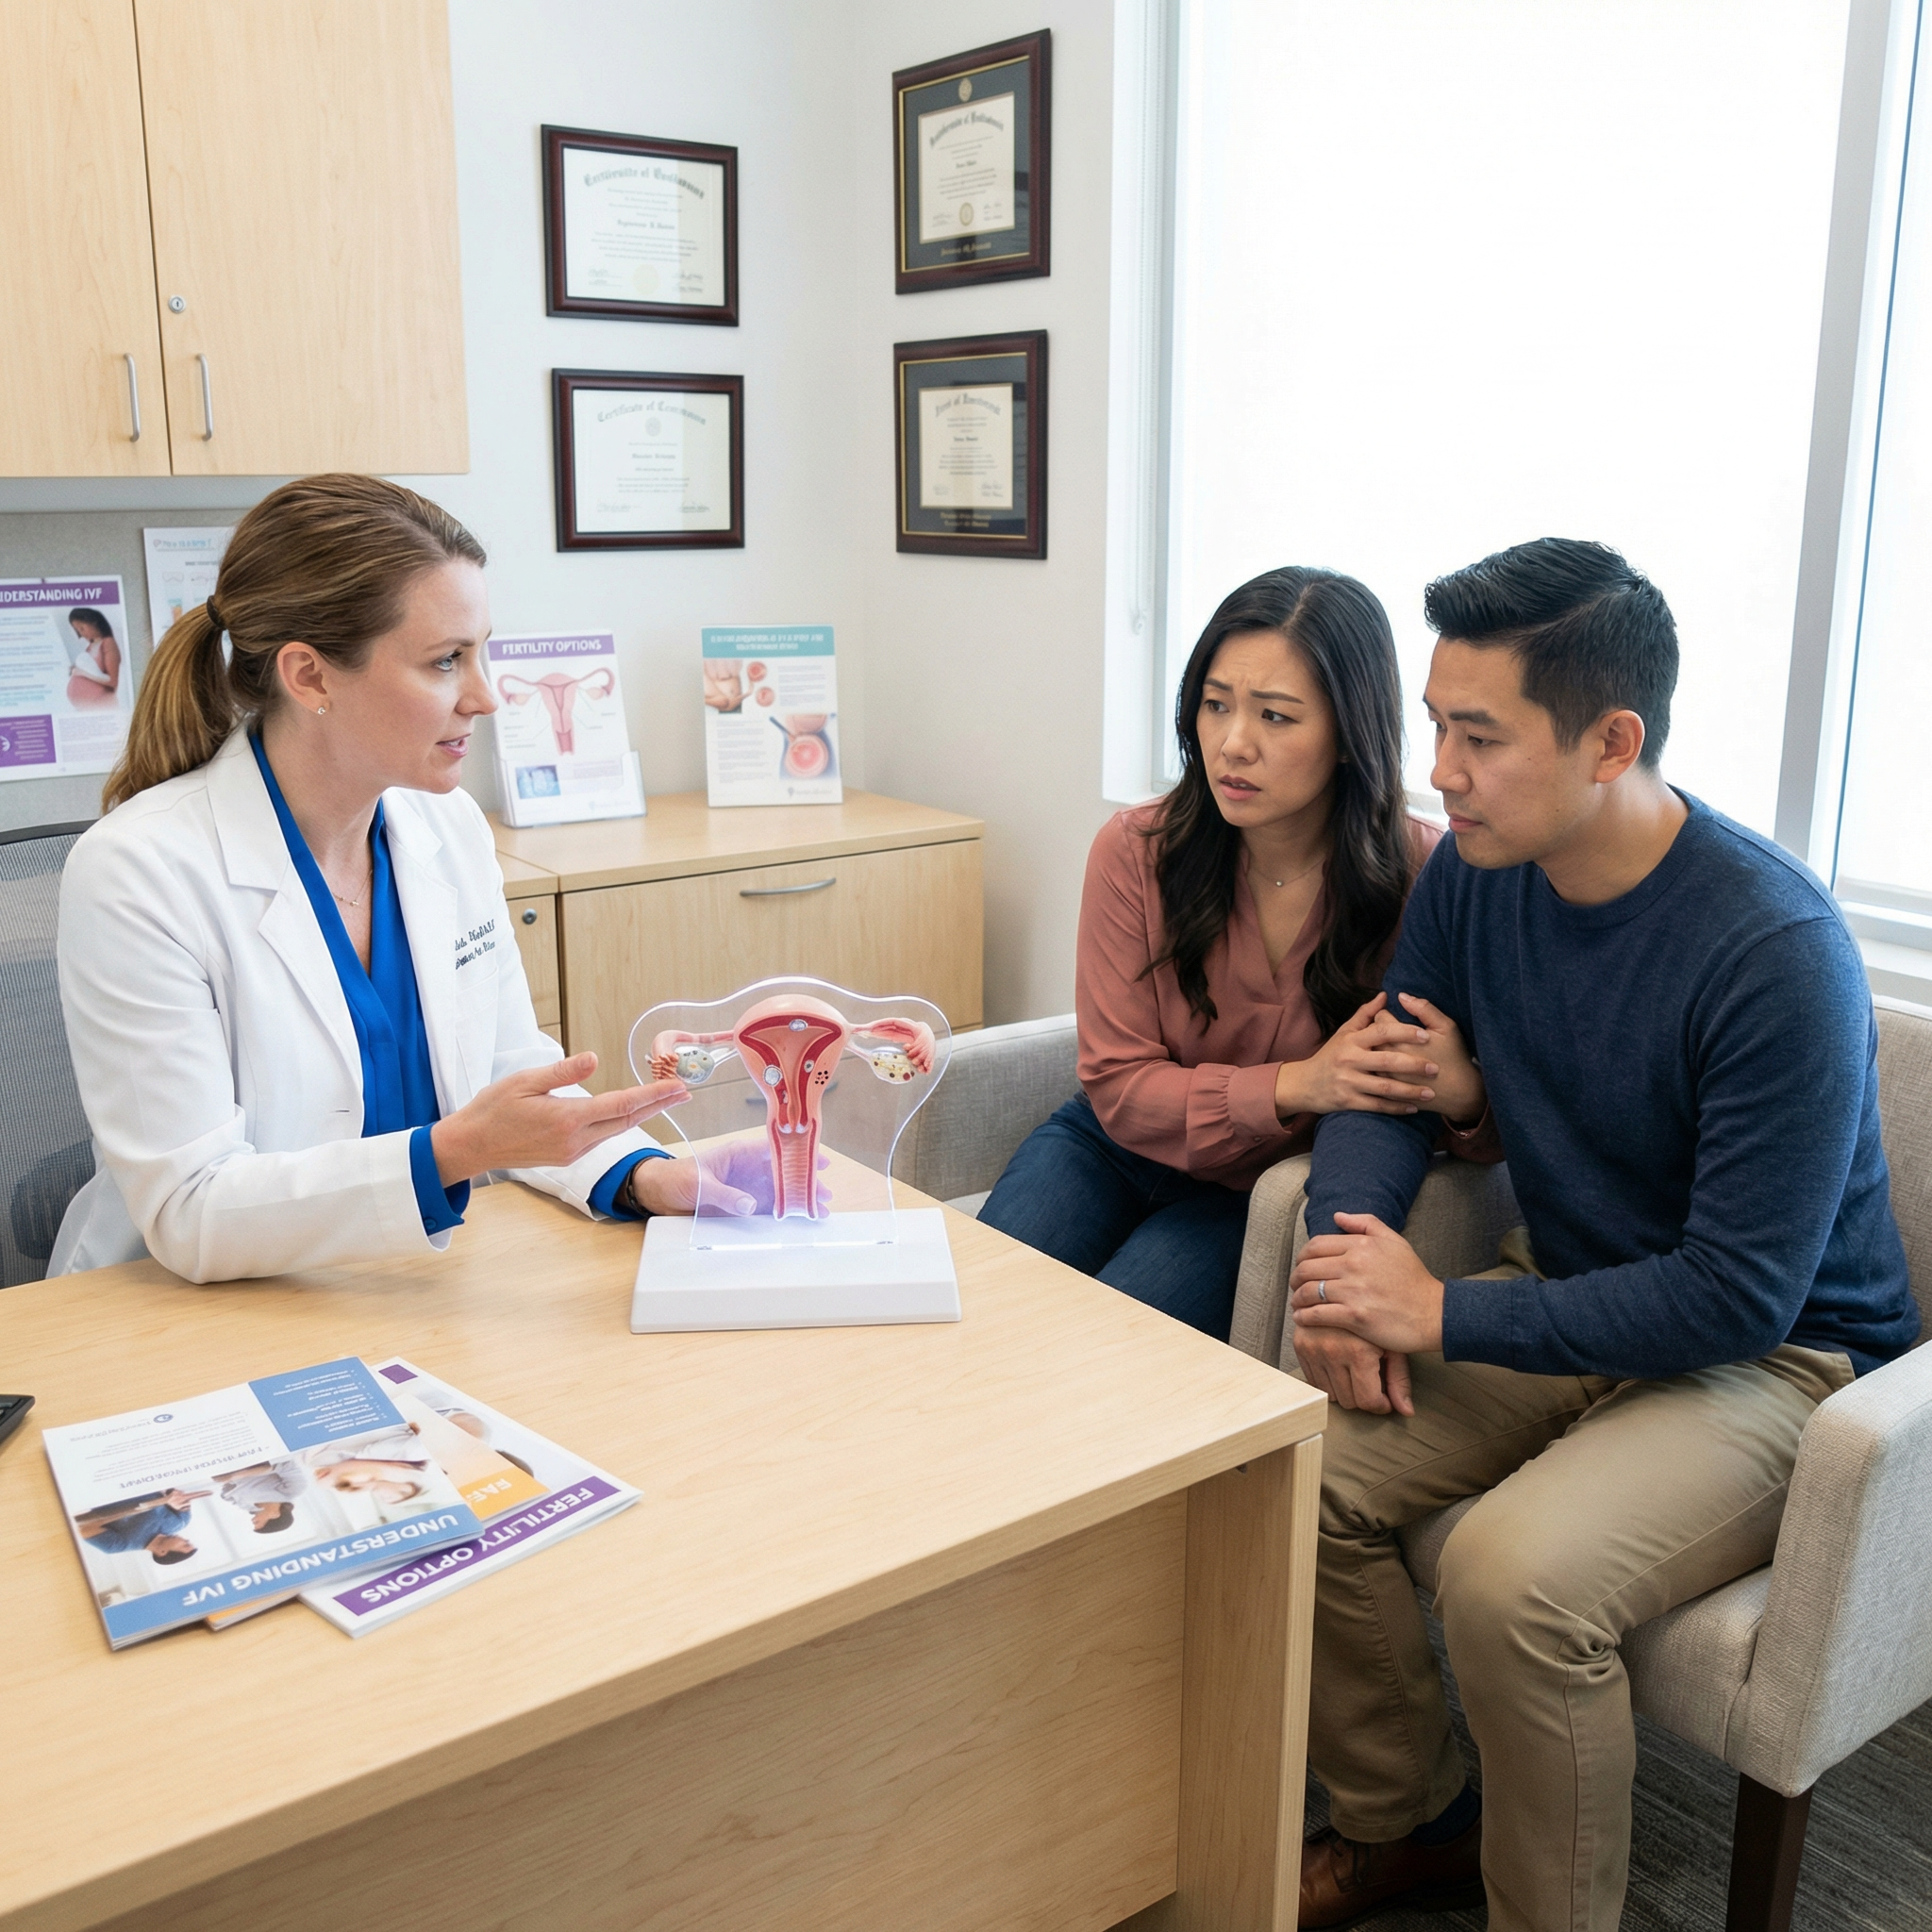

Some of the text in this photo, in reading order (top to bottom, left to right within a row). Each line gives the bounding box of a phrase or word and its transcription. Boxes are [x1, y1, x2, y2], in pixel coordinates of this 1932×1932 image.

[84, 587, 103, 600] IVF
[556, 639, 602, 653] OPTIONS
[182, 1514, 459, 1607] UNDERSTANDING IVF
[360, 1547, 474, 1604] OPTIONS
